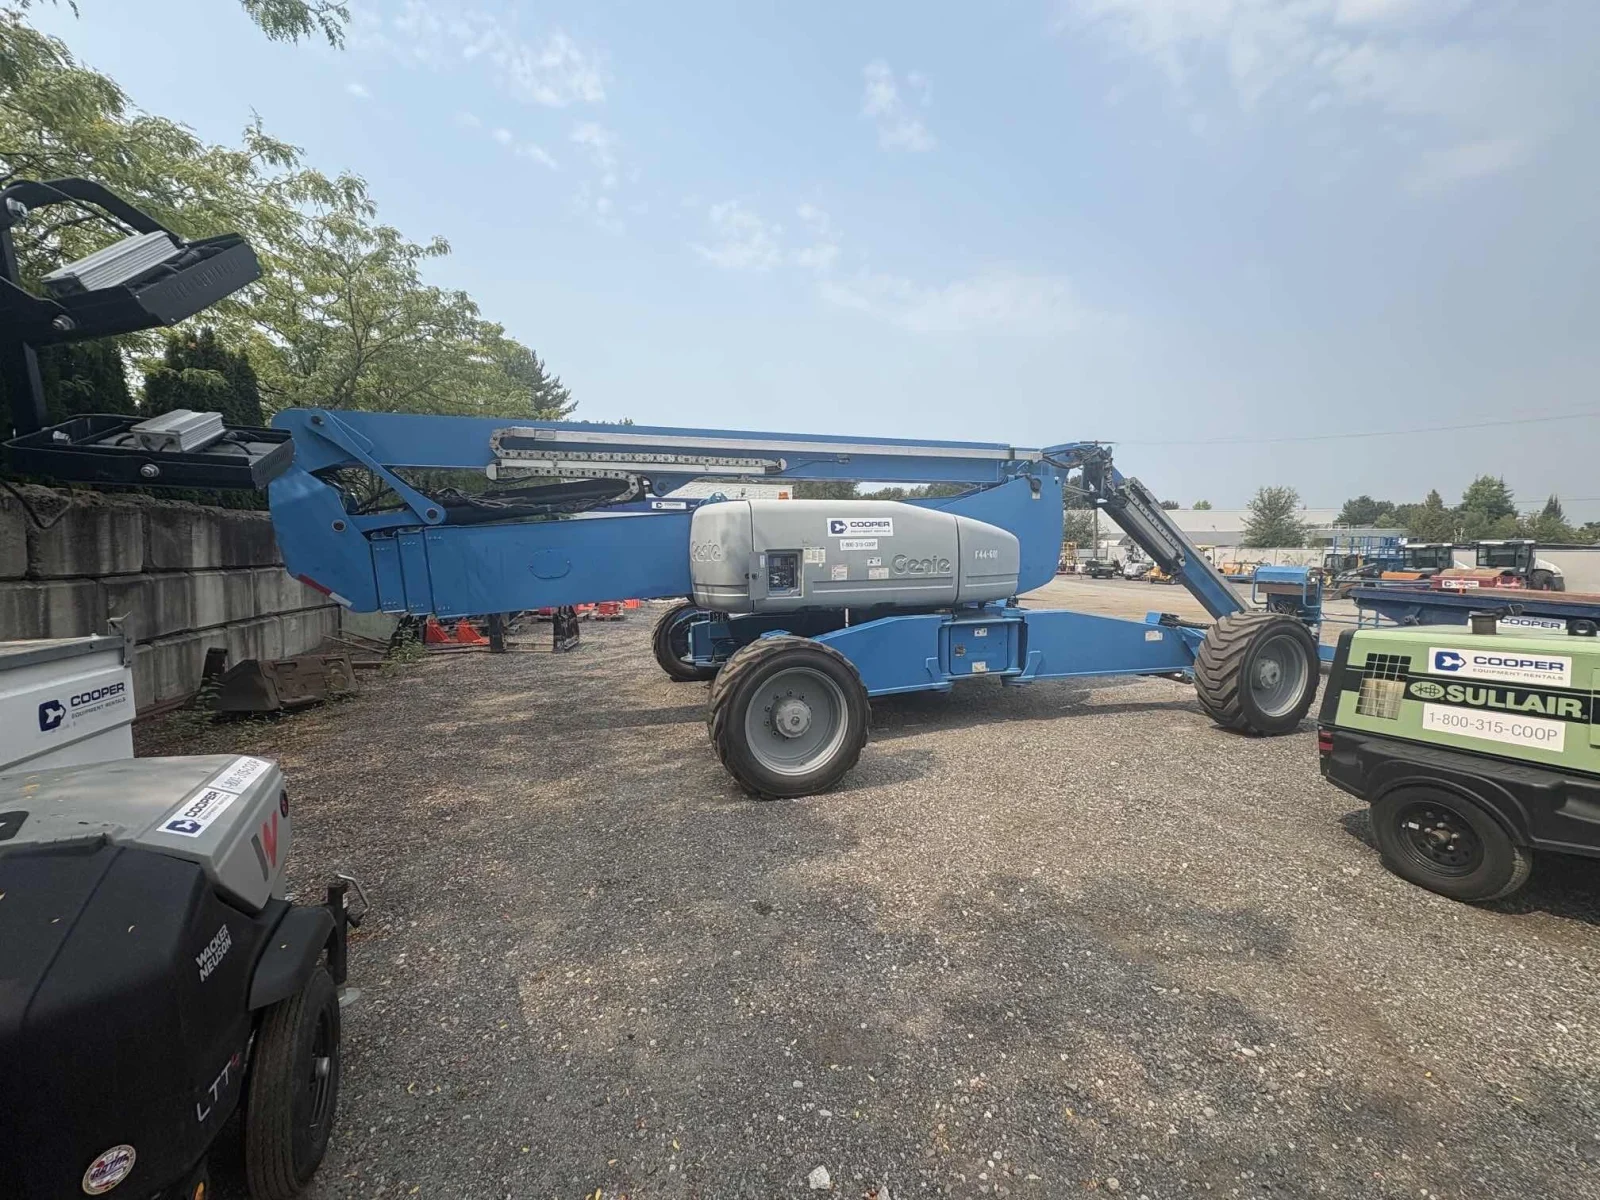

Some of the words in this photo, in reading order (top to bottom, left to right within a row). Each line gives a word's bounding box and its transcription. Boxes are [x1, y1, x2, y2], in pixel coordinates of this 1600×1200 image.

[892, 554, 951, 575] Genie
[1500, 618, 1561, 629] COOPER
[1472, 668, 1521, 677] EQUIPMENT
[1523, 672, 1564, 681] RENTALS
[1473, 656, 1565, 672] COOPER
[70, 682, 125, 707] COOPER
[1446, 684, 1584, 720] SULLAIR
[1429, 711, 1558, 742] 1-800-315-COOP
[184, 791, 220, 818] COOPER
[195, 924, 228, 968] WACKER
[200, 934, 231, 983] NEUSON
